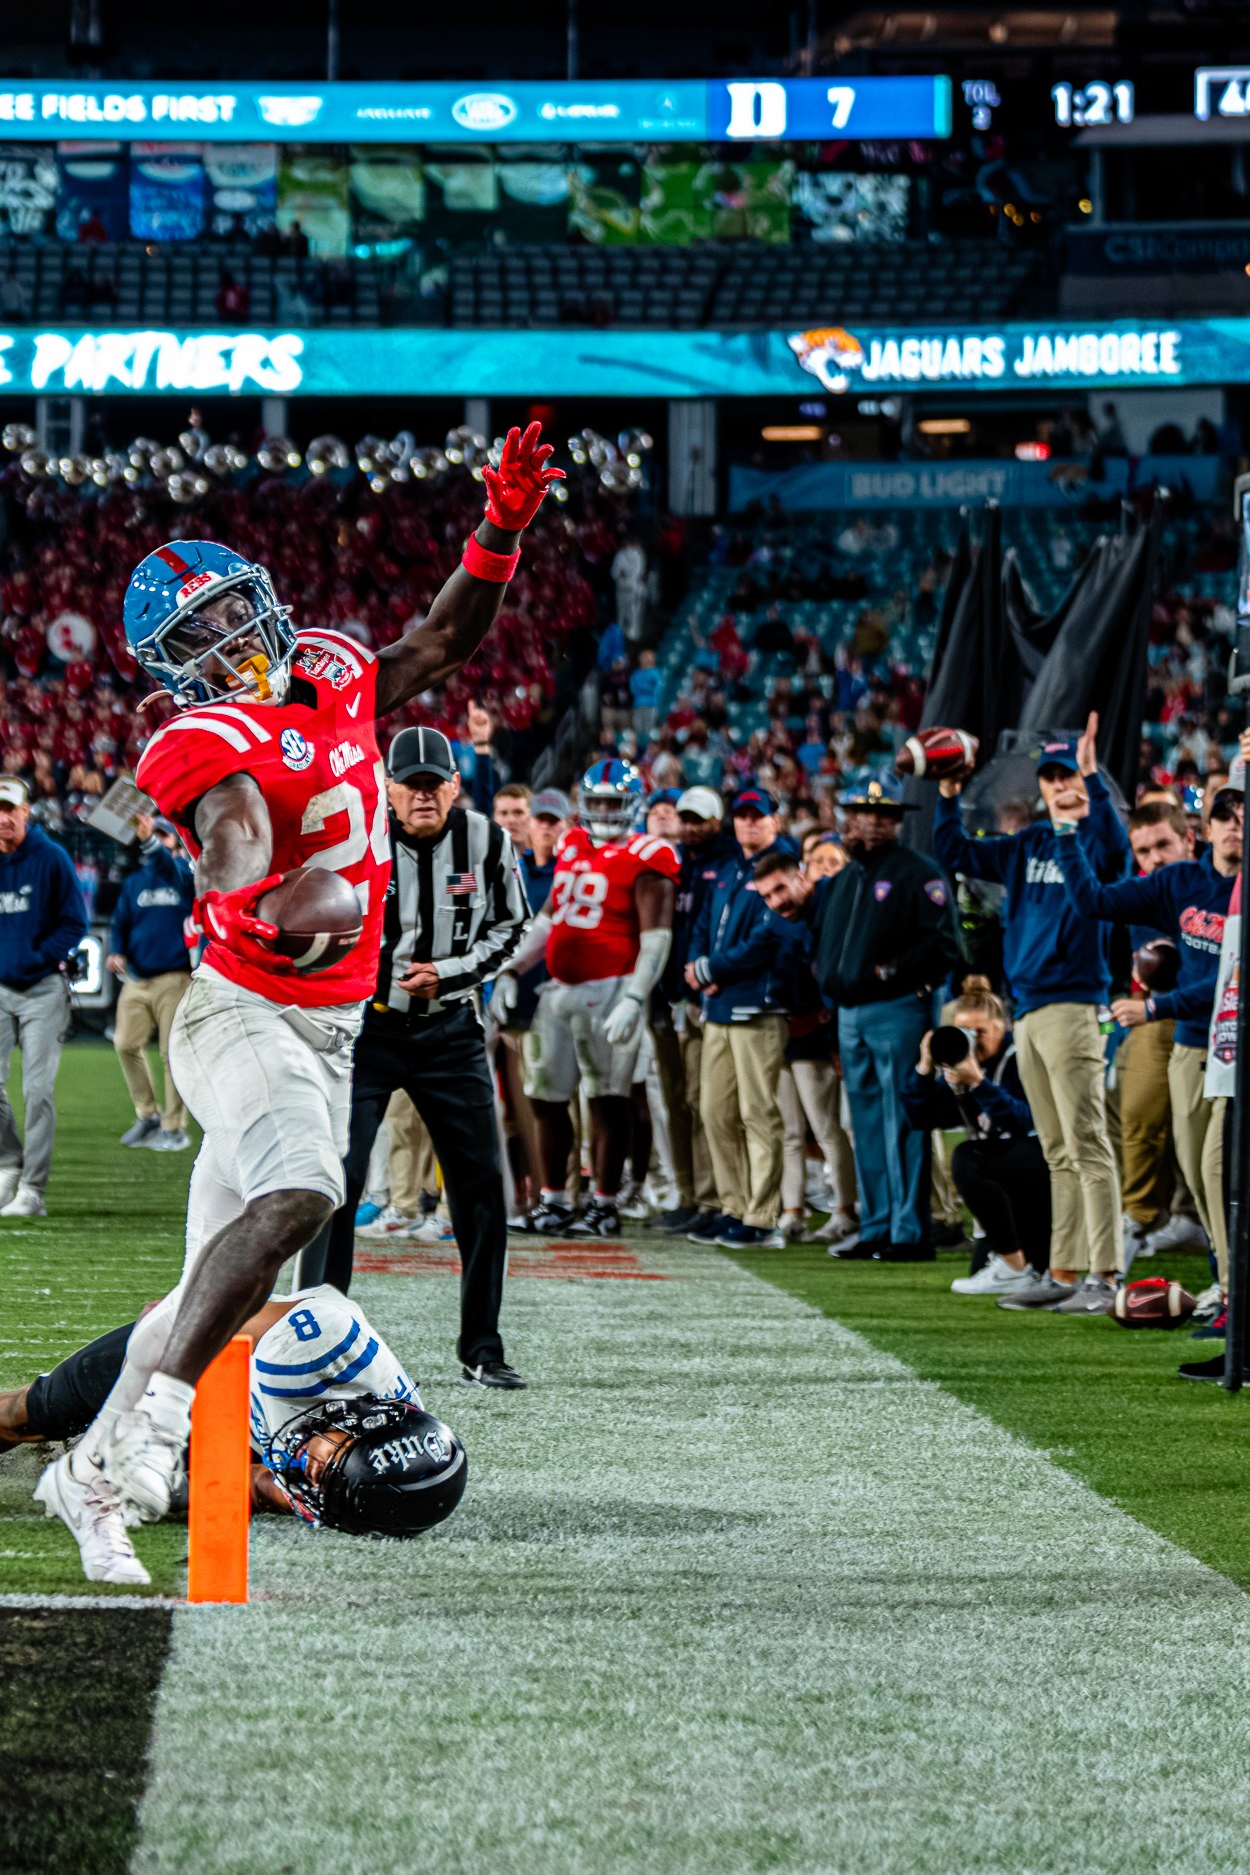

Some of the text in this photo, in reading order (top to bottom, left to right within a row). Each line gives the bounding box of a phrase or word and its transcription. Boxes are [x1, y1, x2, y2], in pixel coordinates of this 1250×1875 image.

[41, 94, 148, 122] FIELDS
[152, 94, 237, 122] FIRST
[726, 82, 787, 138] D
[827, 87, 856, 129] 7
[1052, 80, 1134, 127] 1:21
[1218, 76, 1250, 116] 4
[31, 331, 304, 391] PARTNERS
[862, 331, 1182, 380] JAGUARS JAMBOREE
[852, 470, 1006, 499] BUD LIGHT
[180, 572, 212, 598] REBS
[281, 728, 307, 760] SEC
[453, 921, 469, 941] L
[288, 1309, 322, 1342] 8
[368, 1431, 452, 1477] Duke
